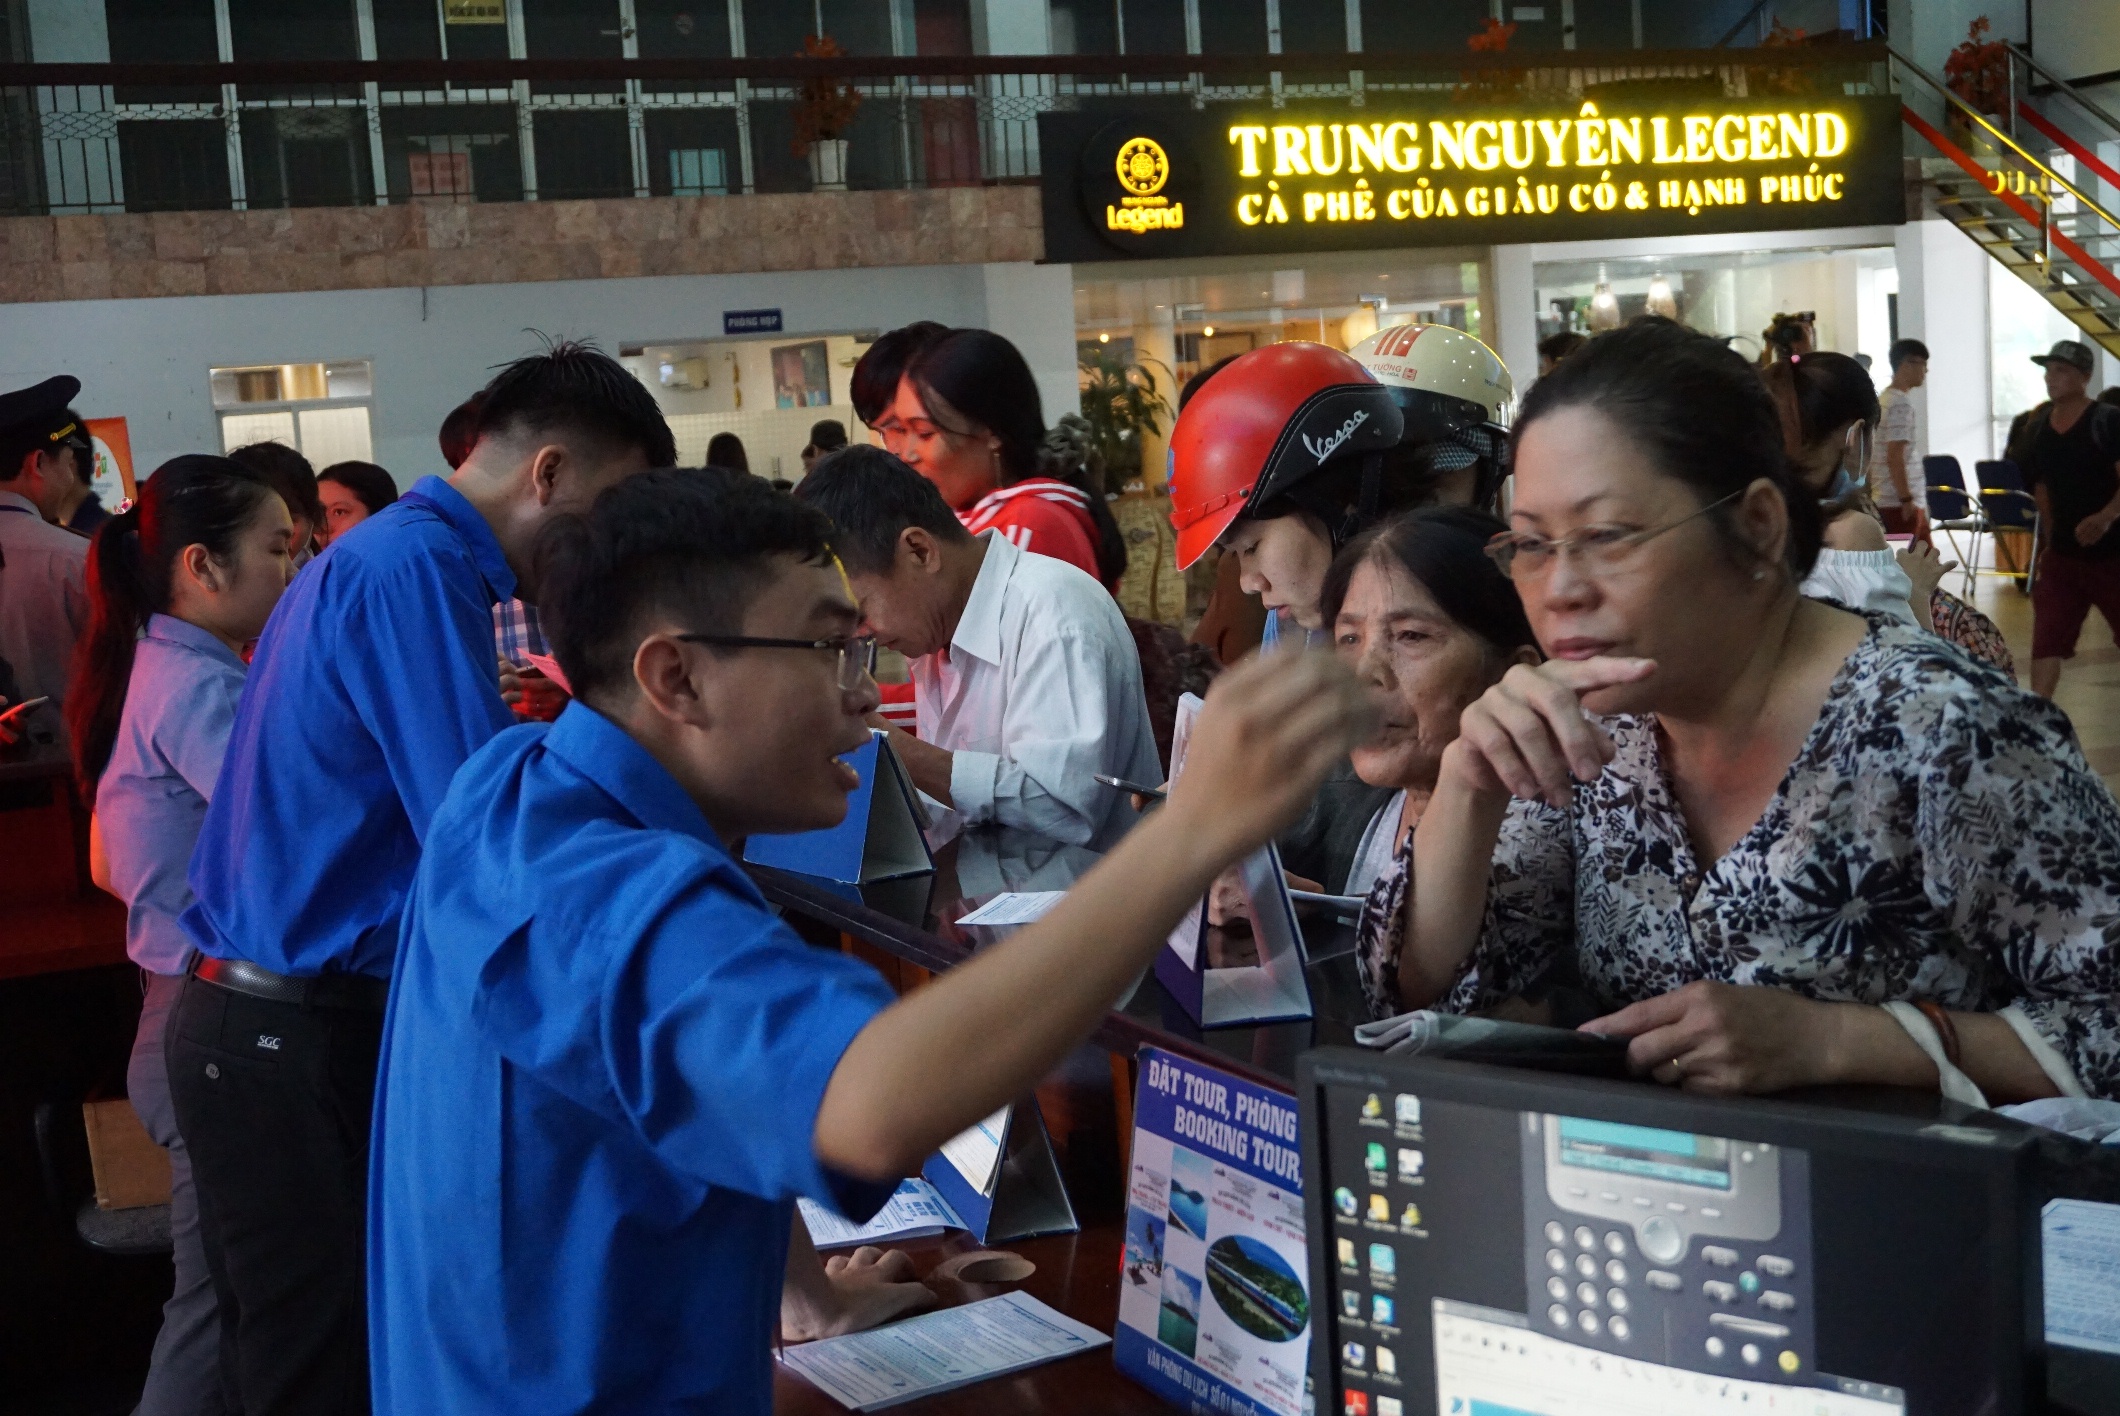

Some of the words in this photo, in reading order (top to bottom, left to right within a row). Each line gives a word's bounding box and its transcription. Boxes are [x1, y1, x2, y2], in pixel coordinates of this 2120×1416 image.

[1228, 121, 1423, 177] TRUNG
[1429, 101, 1642, 170] NGUYÊN
[1650, 112, 1849, 164] LEGEND
[1106, 202, 1184, 234] Legend
[1237, 179, 1289, 225] CÀ
[1303, 178, 1376, 222] PHÊ
[1387, 177, 1459, 220] CỦA
[1465, 175, 1559, 216] GIÀU
[1569, 170, 1618, 212] CÓ
[1624, 182, 1649, 210] &
[1658, 177, 1747, 216] HẠNH
[1759, 162, 1844, 203] PHÚC
[1302, 409, 1370, 466] Vespa
[257, 1035, 281, 1048] SGC
[1148, 1058, 1181, 1097] ĐẶT
[1184, 1072, 1231, 1121] TOUR,
[1234, 1091, 1297, 1142] PHÒNG
[1174, 1105, 1248, 1162] BOOKING
